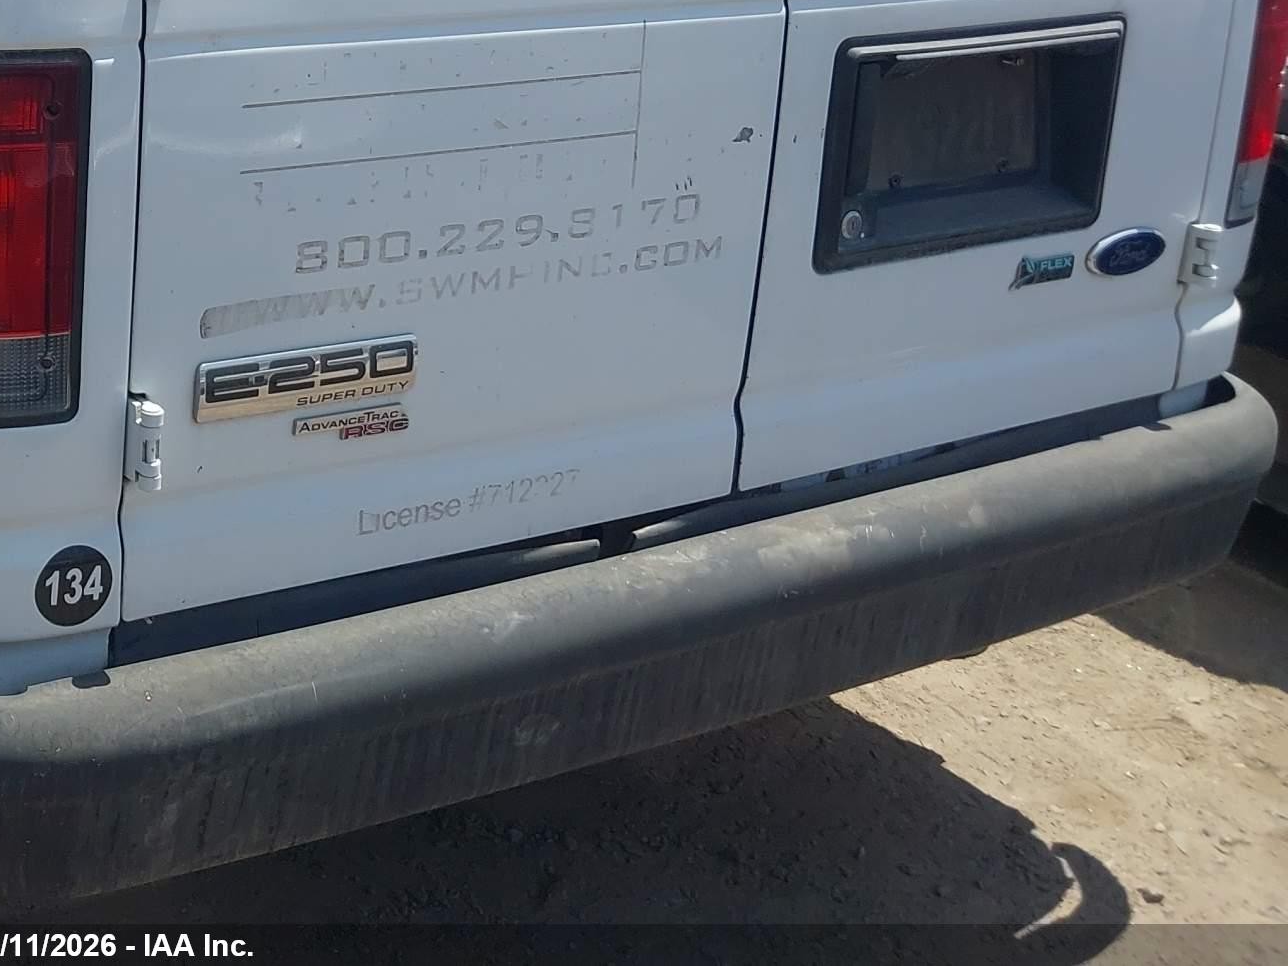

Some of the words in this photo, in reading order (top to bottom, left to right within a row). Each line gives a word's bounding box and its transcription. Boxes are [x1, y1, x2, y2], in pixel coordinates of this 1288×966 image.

[296, 192, 701, 274] 800.229.8170
[1040, 256, 1073, 271] FLEX
[205, 340, 414, 404] E-250
[296, 390, 355, 407] SUPER
[361, 380, 409, 397] DUTY
[343, 418, 409, 440] RSC
[357, 497, 461, 536] License
[45, 565, 104, 606] 134
